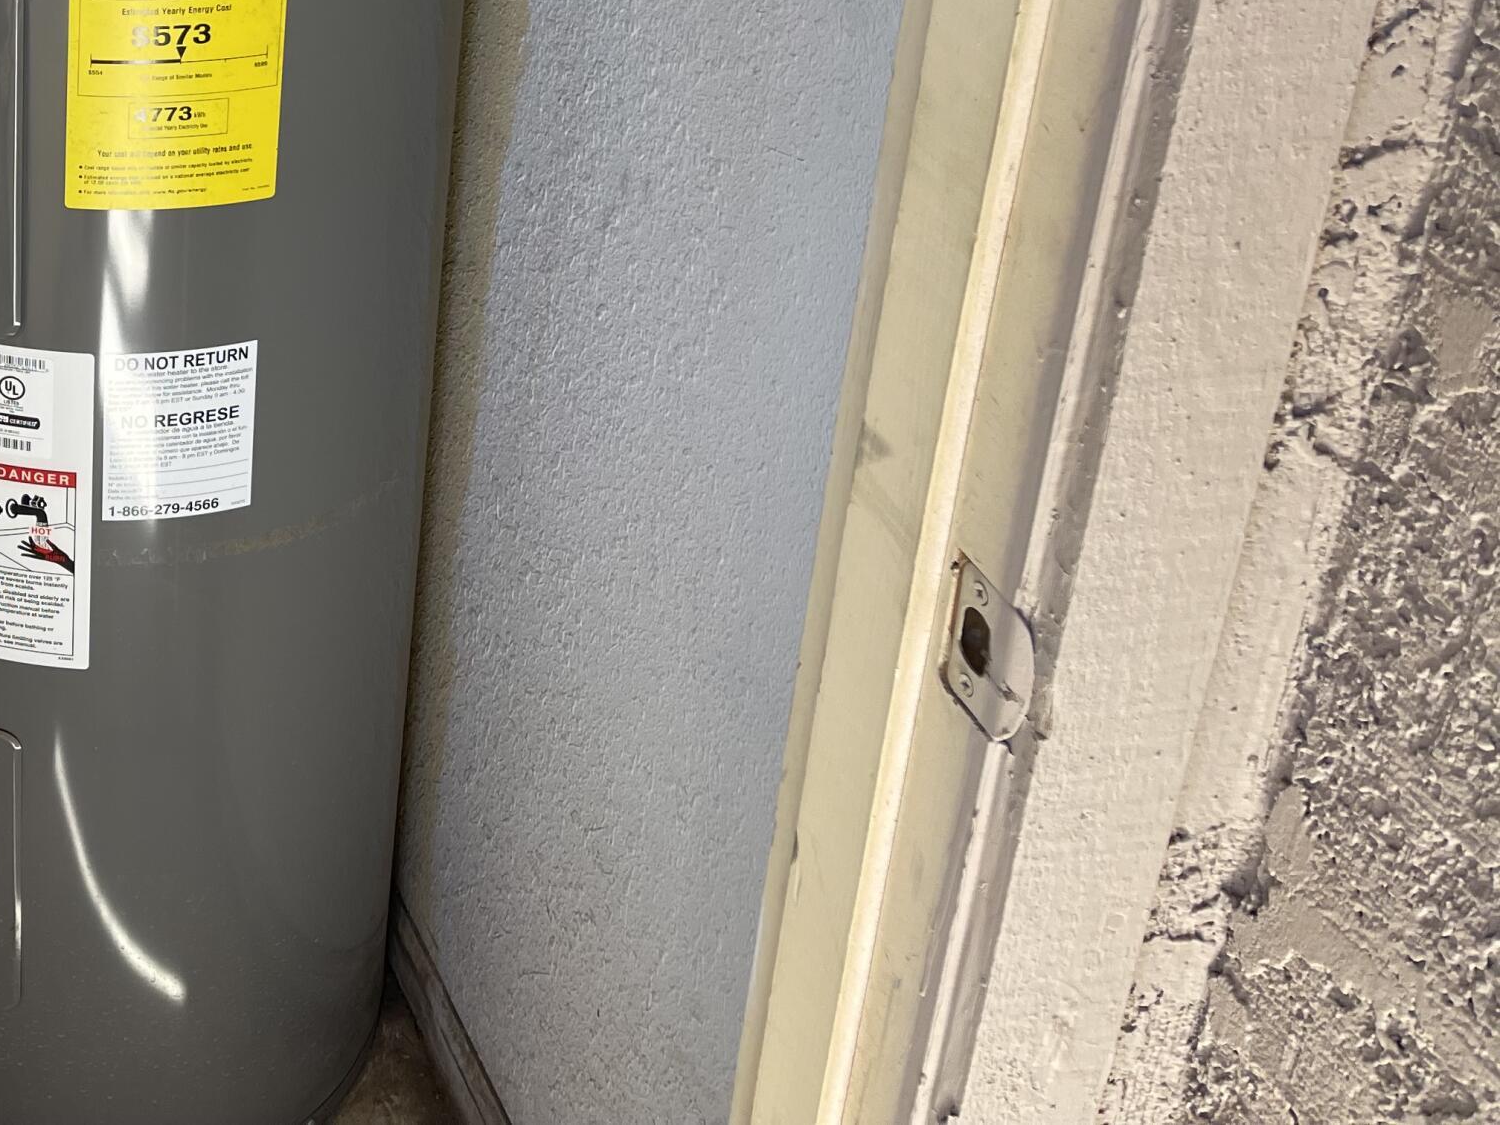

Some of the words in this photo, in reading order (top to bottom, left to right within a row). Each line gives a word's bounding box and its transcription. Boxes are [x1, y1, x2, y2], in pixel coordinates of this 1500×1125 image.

[162, 7, 186, 16] Yearly
[188, 6, 214, 15] Energy
[216, 4, 232, 12] Cost
[131, 23, 212, 47] $573
[114, 357, 139, 372] DO
[144, 355, 179, 371] NOT
[183, 346, 249, 368] RETURN
[5, 380, 19, 396] UL
[154, 405, 240, 428] REGRESE
[108, 497, 219, 517] 1-866-279-4566
[31, 527, 52, 535] HOT
